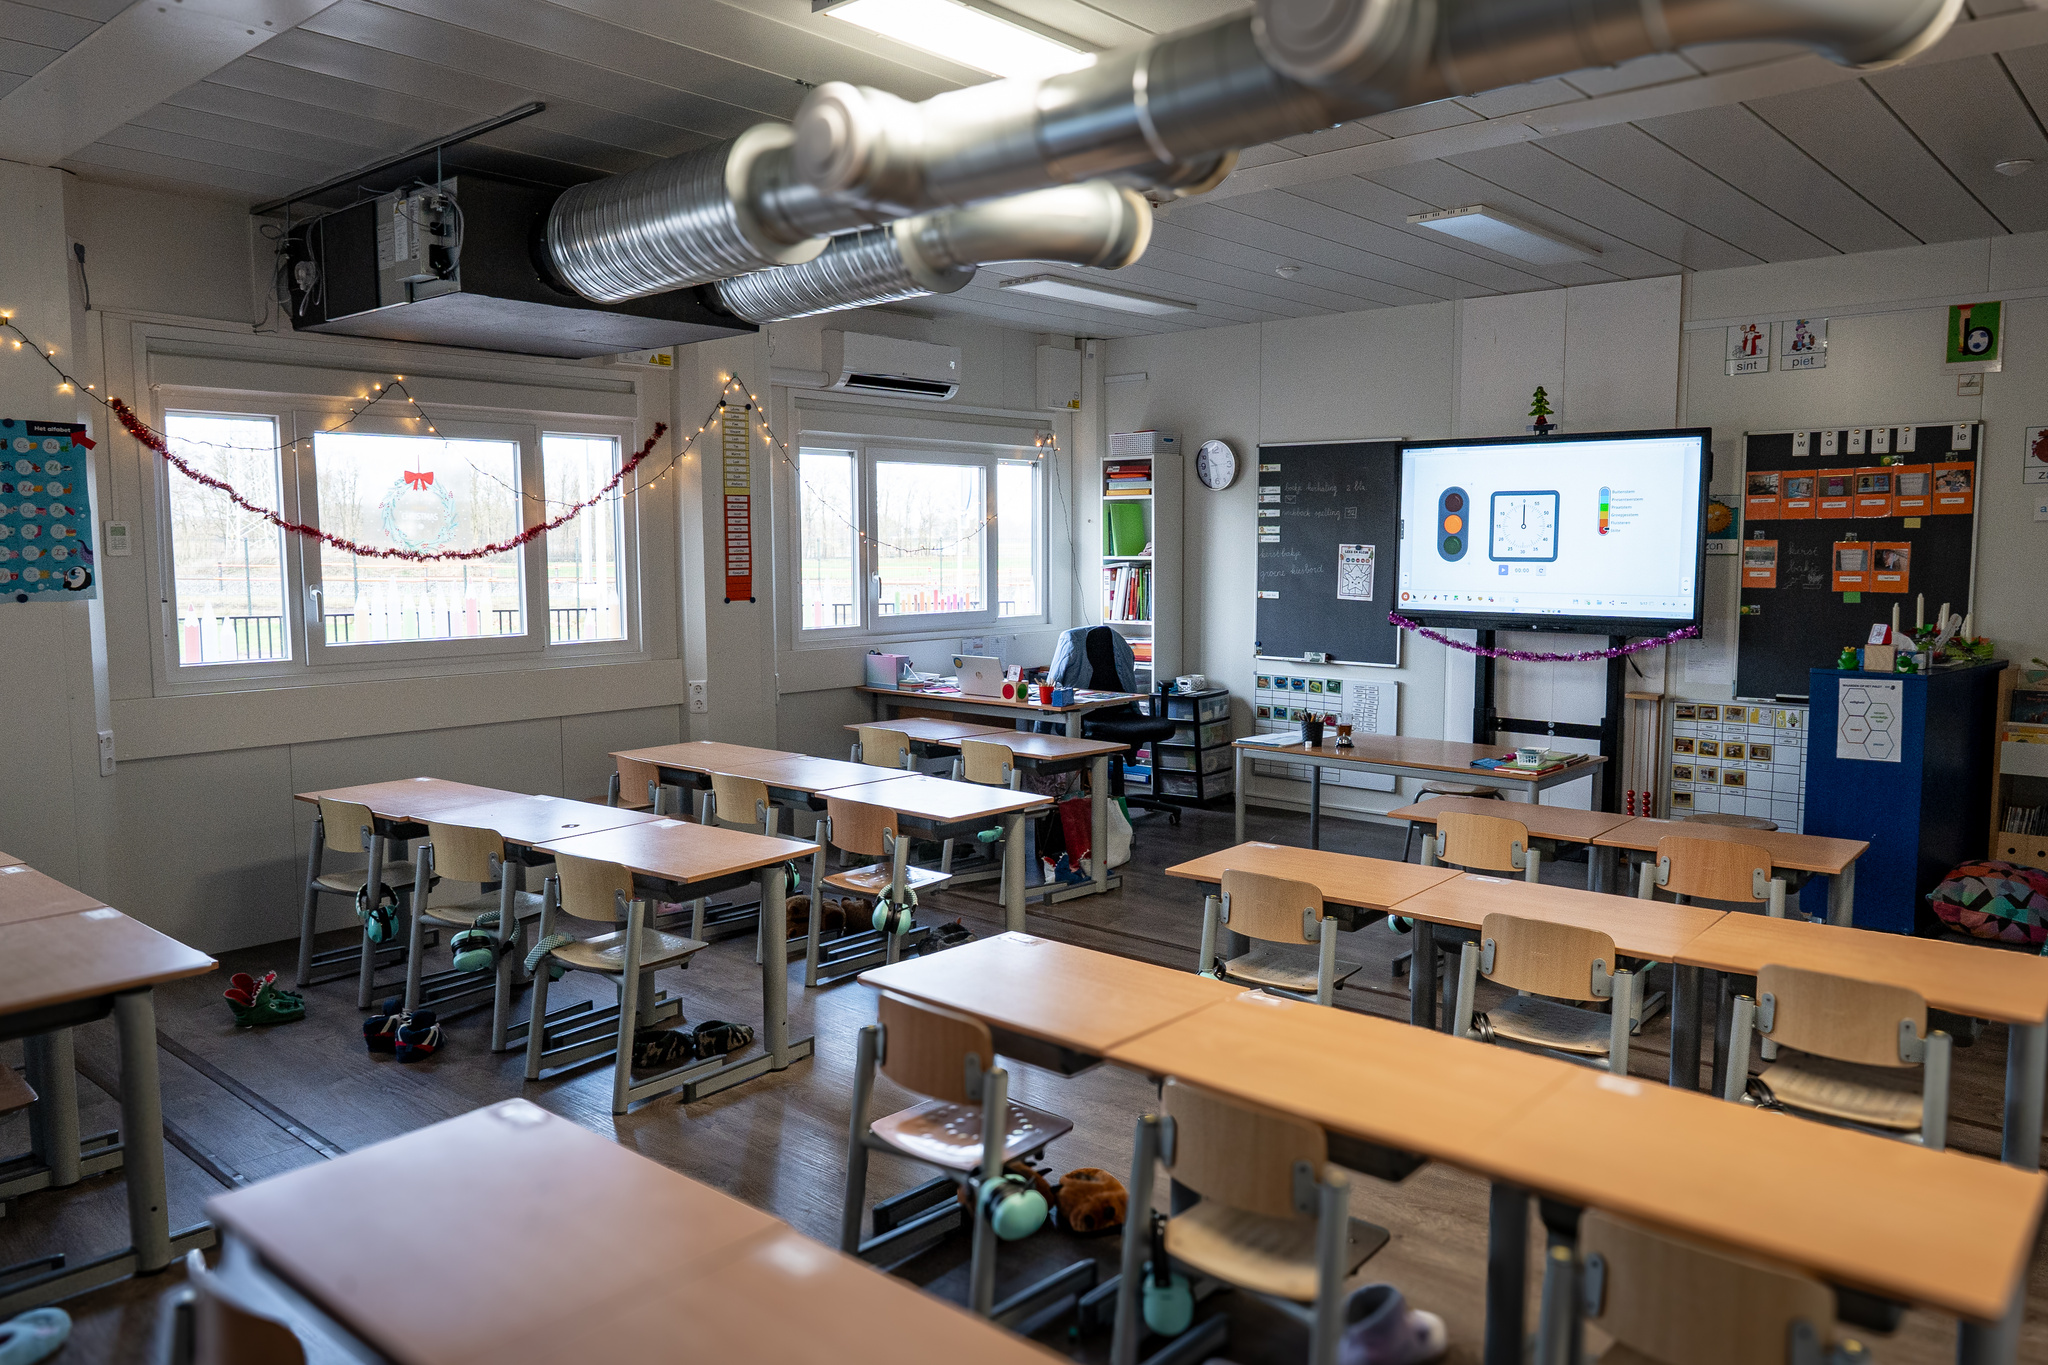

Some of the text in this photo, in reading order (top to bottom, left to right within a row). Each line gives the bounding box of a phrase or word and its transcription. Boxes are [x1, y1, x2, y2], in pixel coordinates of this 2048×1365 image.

[1962, 317, 1994, 356] b
[1736, 360, 1758, 371] sint
[1792, 356, 1815, 368] piet
[1877, 437, 1884, 445] u
[1903, 434, 1908, 445] j
[1956, 431, 1967, 441] ie
[1796, 440, 1806, 448] w
[1825, 439, 1833, 447] o
[1852, 438, 1860, 446] a
[1314, 507, 1341, 521] spelling
